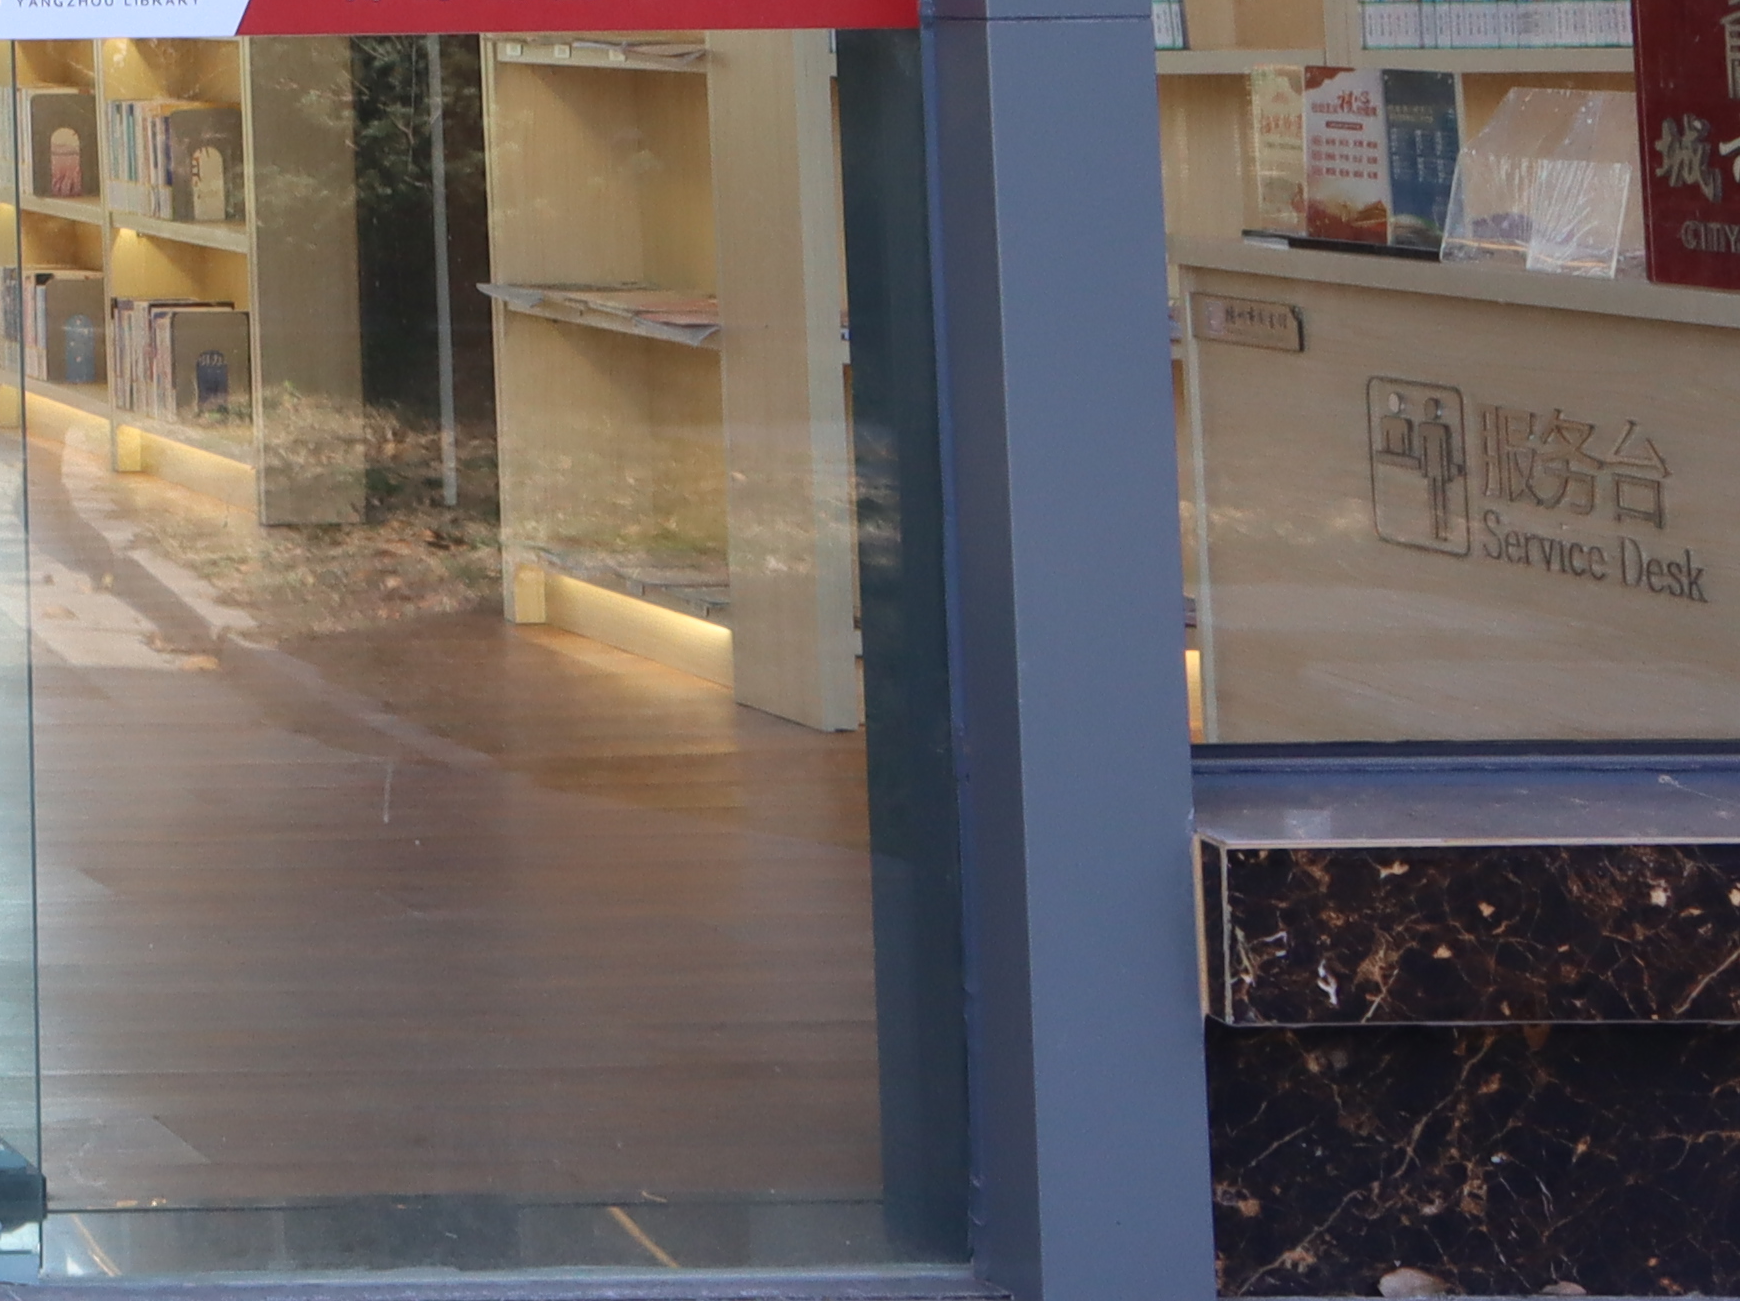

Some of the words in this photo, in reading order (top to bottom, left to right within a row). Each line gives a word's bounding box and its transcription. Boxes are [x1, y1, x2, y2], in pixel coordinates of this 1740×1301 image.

[1480, 402, 1673, 531] 服务台
[1482, 508, 1607, 582] Service
[1618, 536, 1708, 604] Desk
